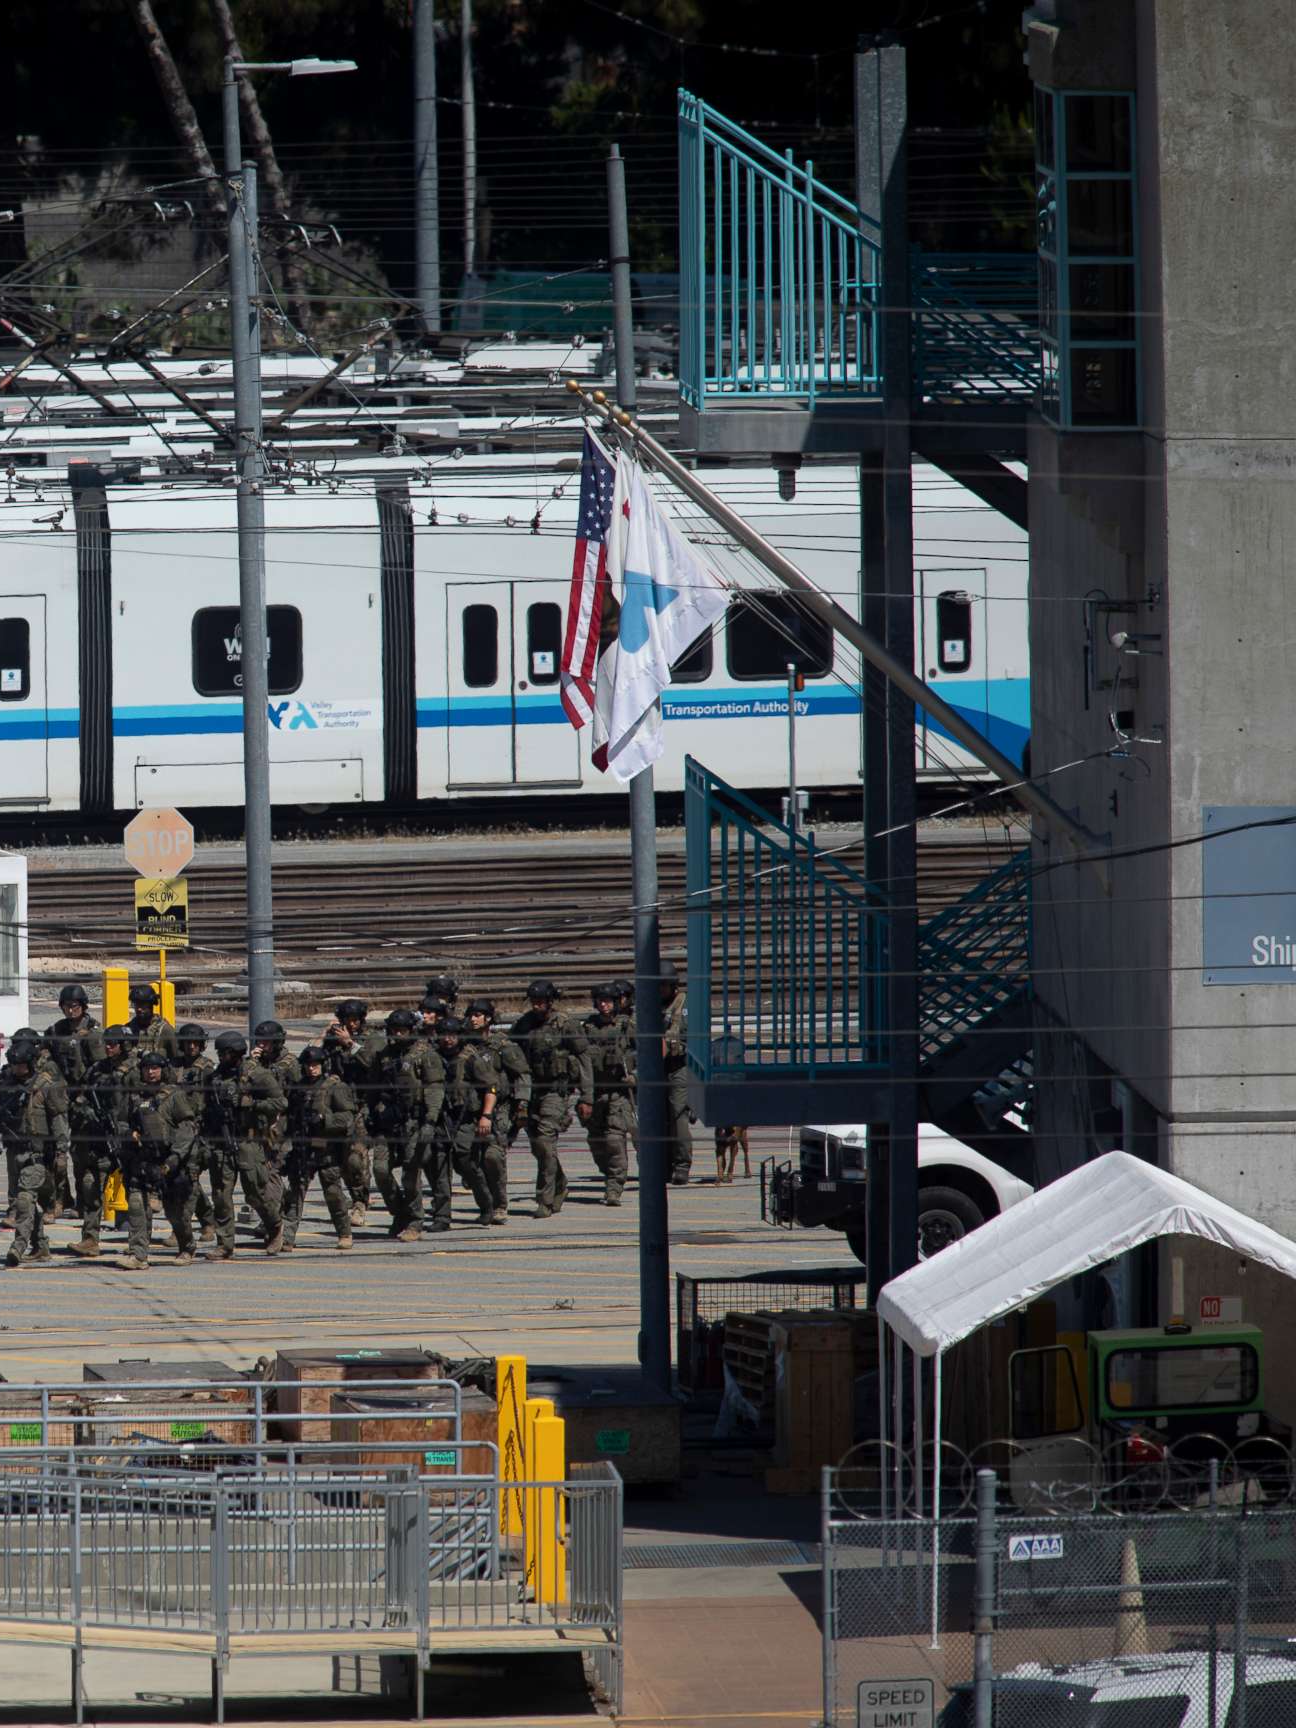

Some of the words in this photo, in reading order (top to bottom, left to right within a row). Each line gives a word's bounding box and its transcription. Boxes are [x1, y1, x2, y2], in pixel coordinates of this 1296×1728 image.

[317, 710, 371, 719] Transportation
[664, 702, 750, 717] Transportation
[753, 700, 809, 714] Authoity
[323, 720, 360, 729] Authority
[130, 830, 190, 857] STOP
[149, 891, 174, 903] SLOW
[148, 914, 177, 924] BLIND
[1203, 1299, 1219, 1316] NO
[1031, 1538, 1061, 1552] AAA
[867, 1689, 926, 1706] SPEED
[873, 1712, 918, 1728] LIMIT
